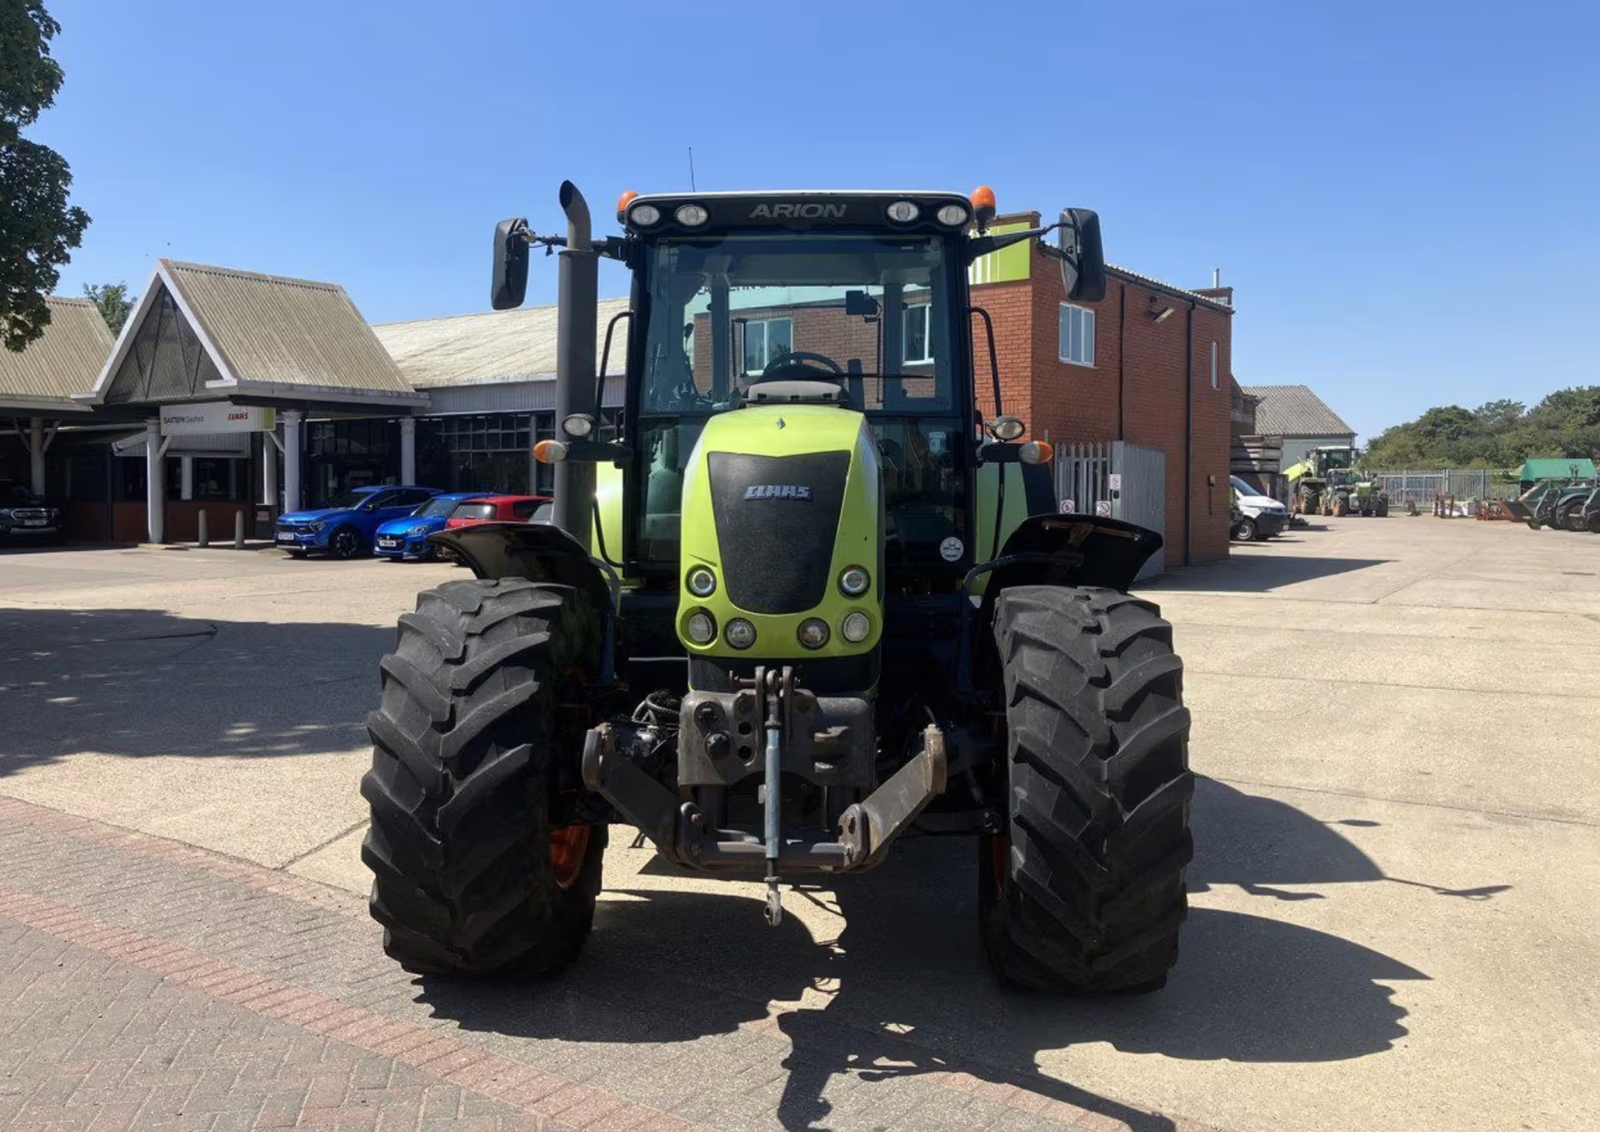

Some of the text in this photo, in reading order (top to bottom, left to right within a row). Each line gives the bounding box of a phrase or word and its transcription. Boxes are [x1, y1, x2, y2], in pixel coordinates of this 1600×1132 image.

[748, 203, 847, 218] ARION
[227, 411, 249, 421] CLAAS
[743, 484, 812, 500] CLAAS
